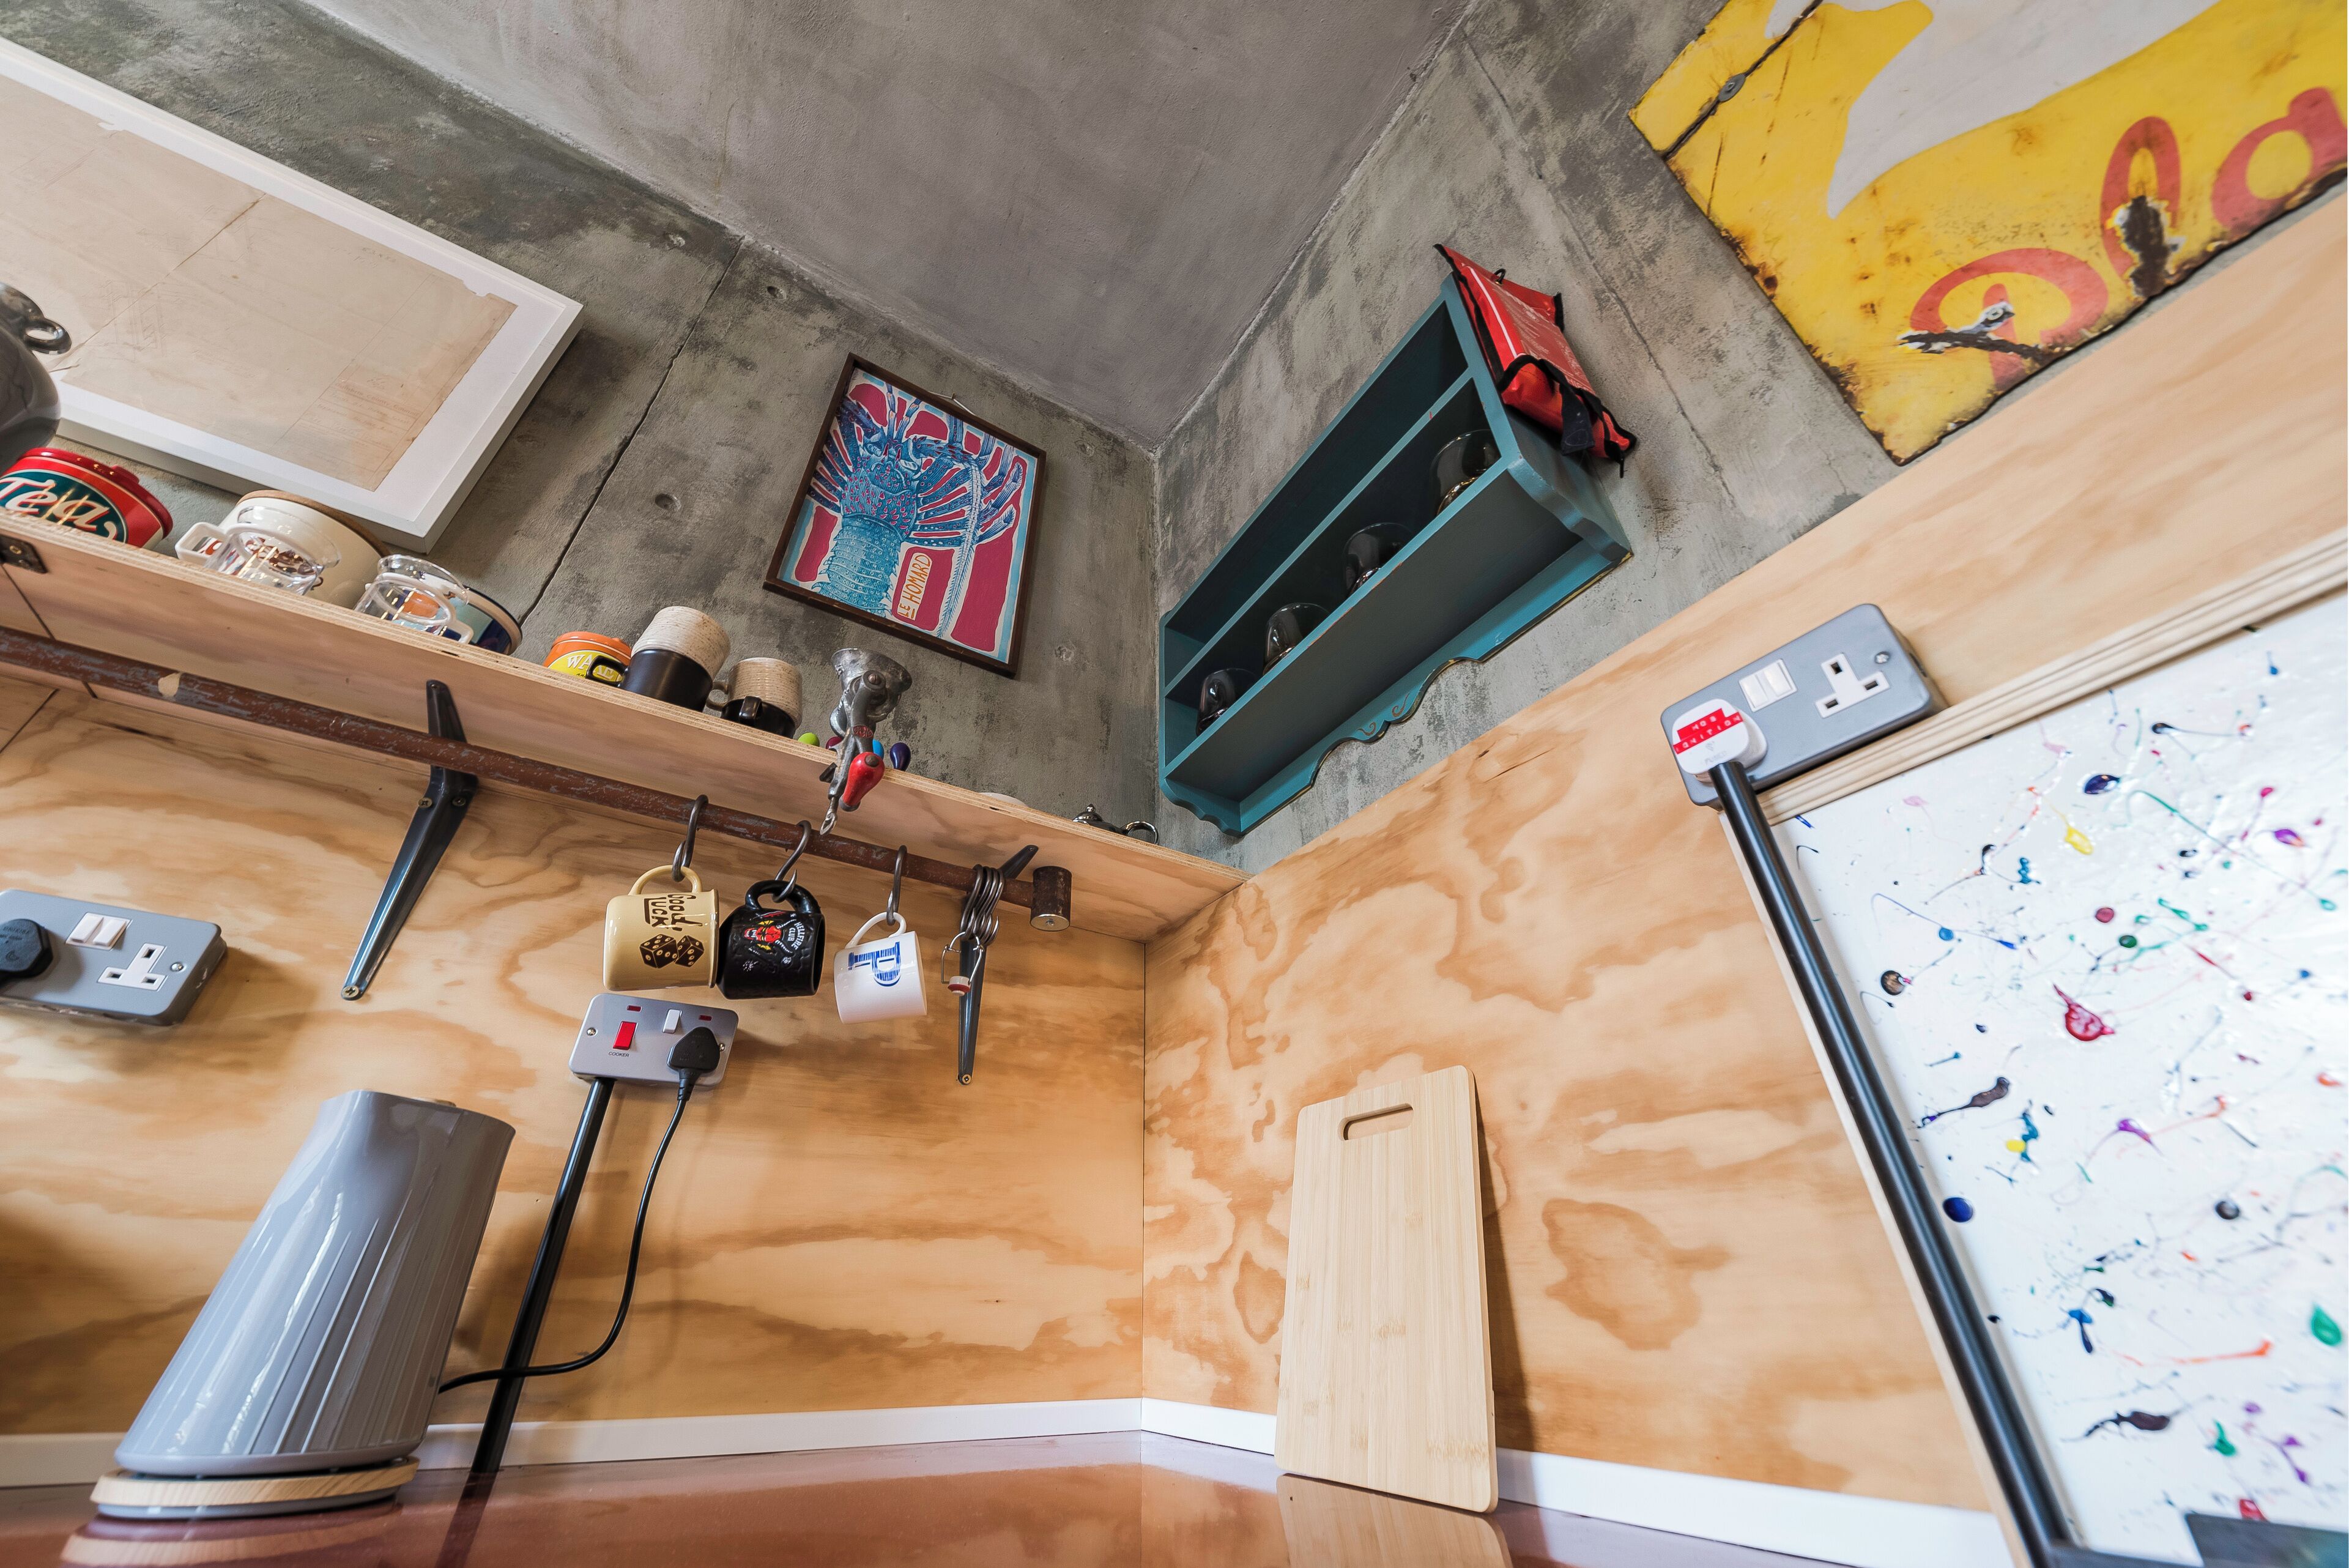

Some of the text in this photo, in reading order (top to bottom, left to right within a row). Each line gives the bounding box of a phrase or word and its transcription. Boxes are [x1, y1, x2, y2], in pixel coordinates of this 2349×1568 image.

[897, 554, 930, 617] LE HOMARD
[1675, 715, 1742, 752] IGNITION
[787, 927, 796, 942] CLUB
[794, 921, 806, 950] HELLFIRE
[847, 942, 902, 987] P
